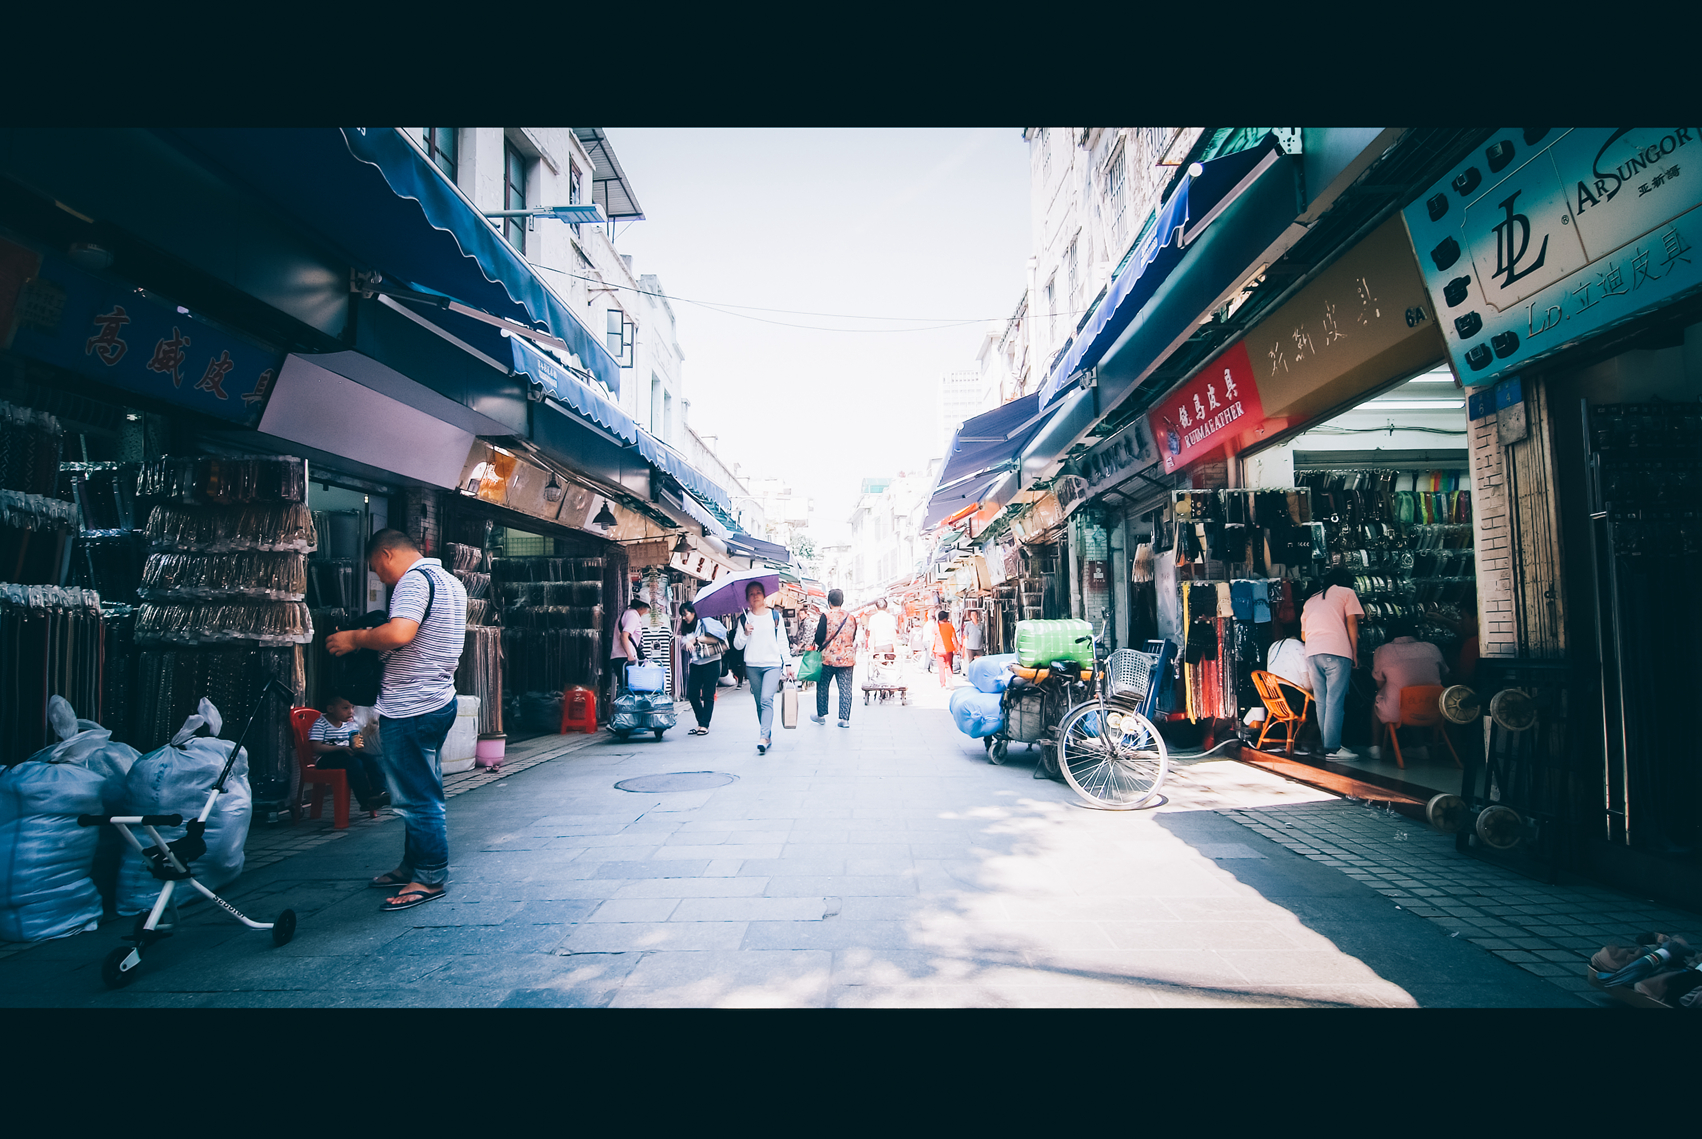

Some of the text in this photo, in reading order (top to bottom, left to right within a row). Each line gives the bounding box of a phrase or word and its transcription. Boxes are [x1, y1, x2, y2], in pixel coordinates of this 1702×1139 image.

[1572, 227, 1692, 315] 立迪皮具
[1404, 306, 1428, 328] 6A
[1478, 402, 1485, 415] 6
